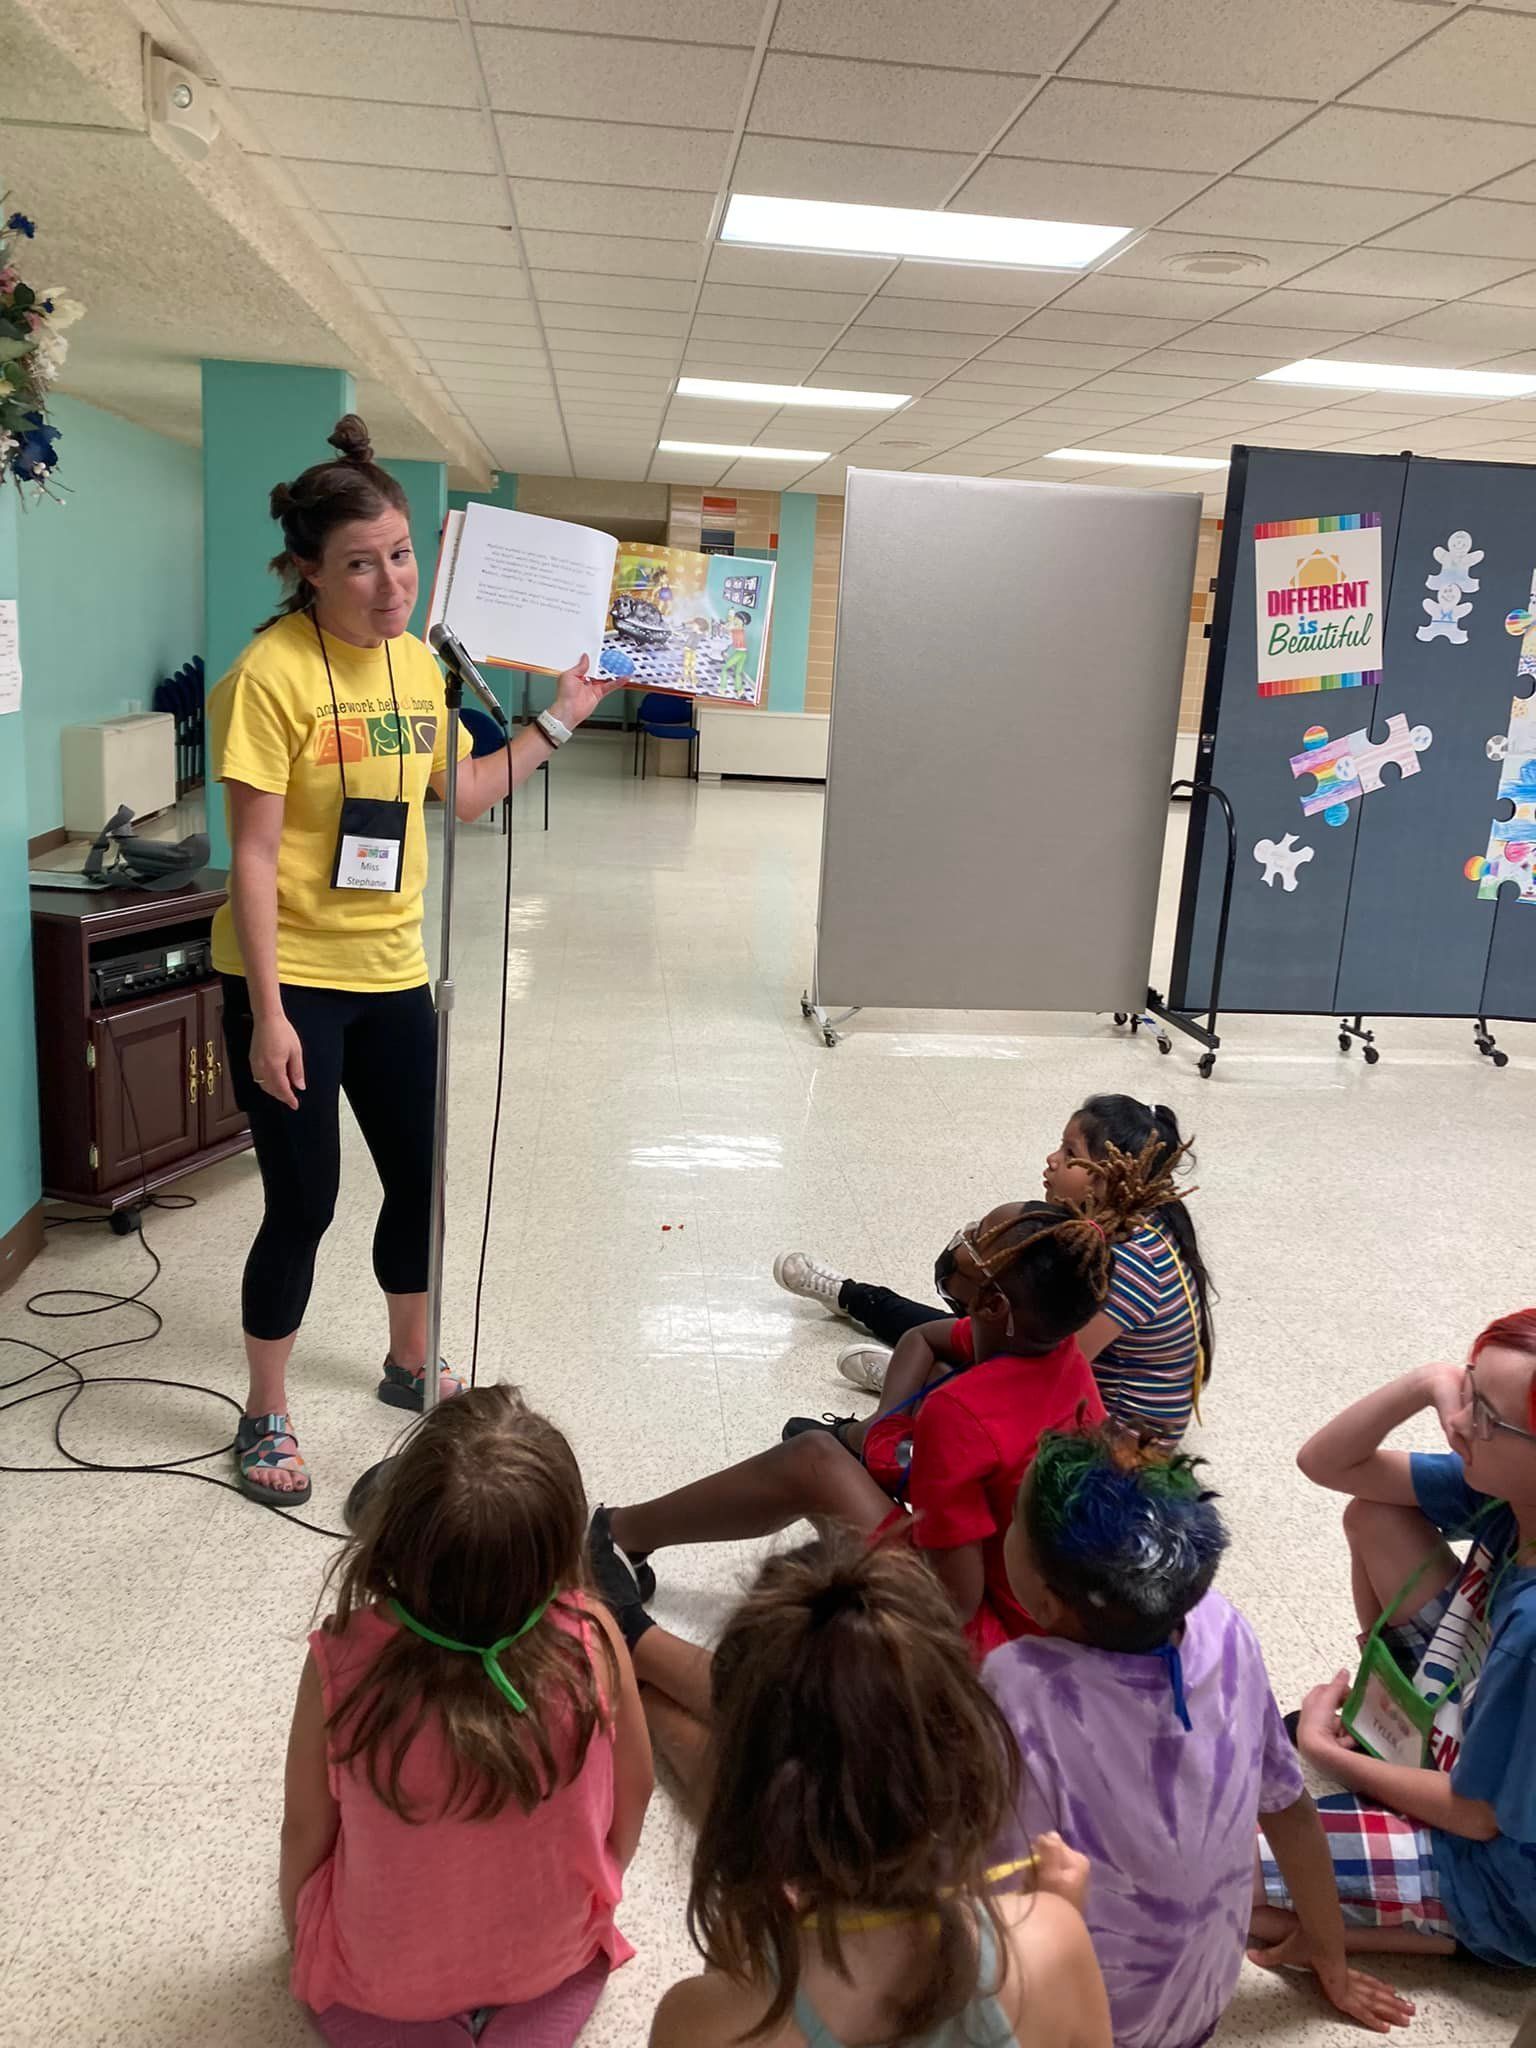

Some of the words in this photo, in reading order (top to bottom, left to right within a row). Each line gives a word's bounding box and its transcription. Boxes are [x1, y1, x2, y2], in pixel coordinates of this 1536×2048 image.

[1267, 580, 1369, 618] DIFFERENT
[1268, 612, 1374, 656] Beautiful
[1298, 615, 1319, 635] is
[360, 861, 380, 872] Miss
[346, 876, 387, 888] Stephanie
